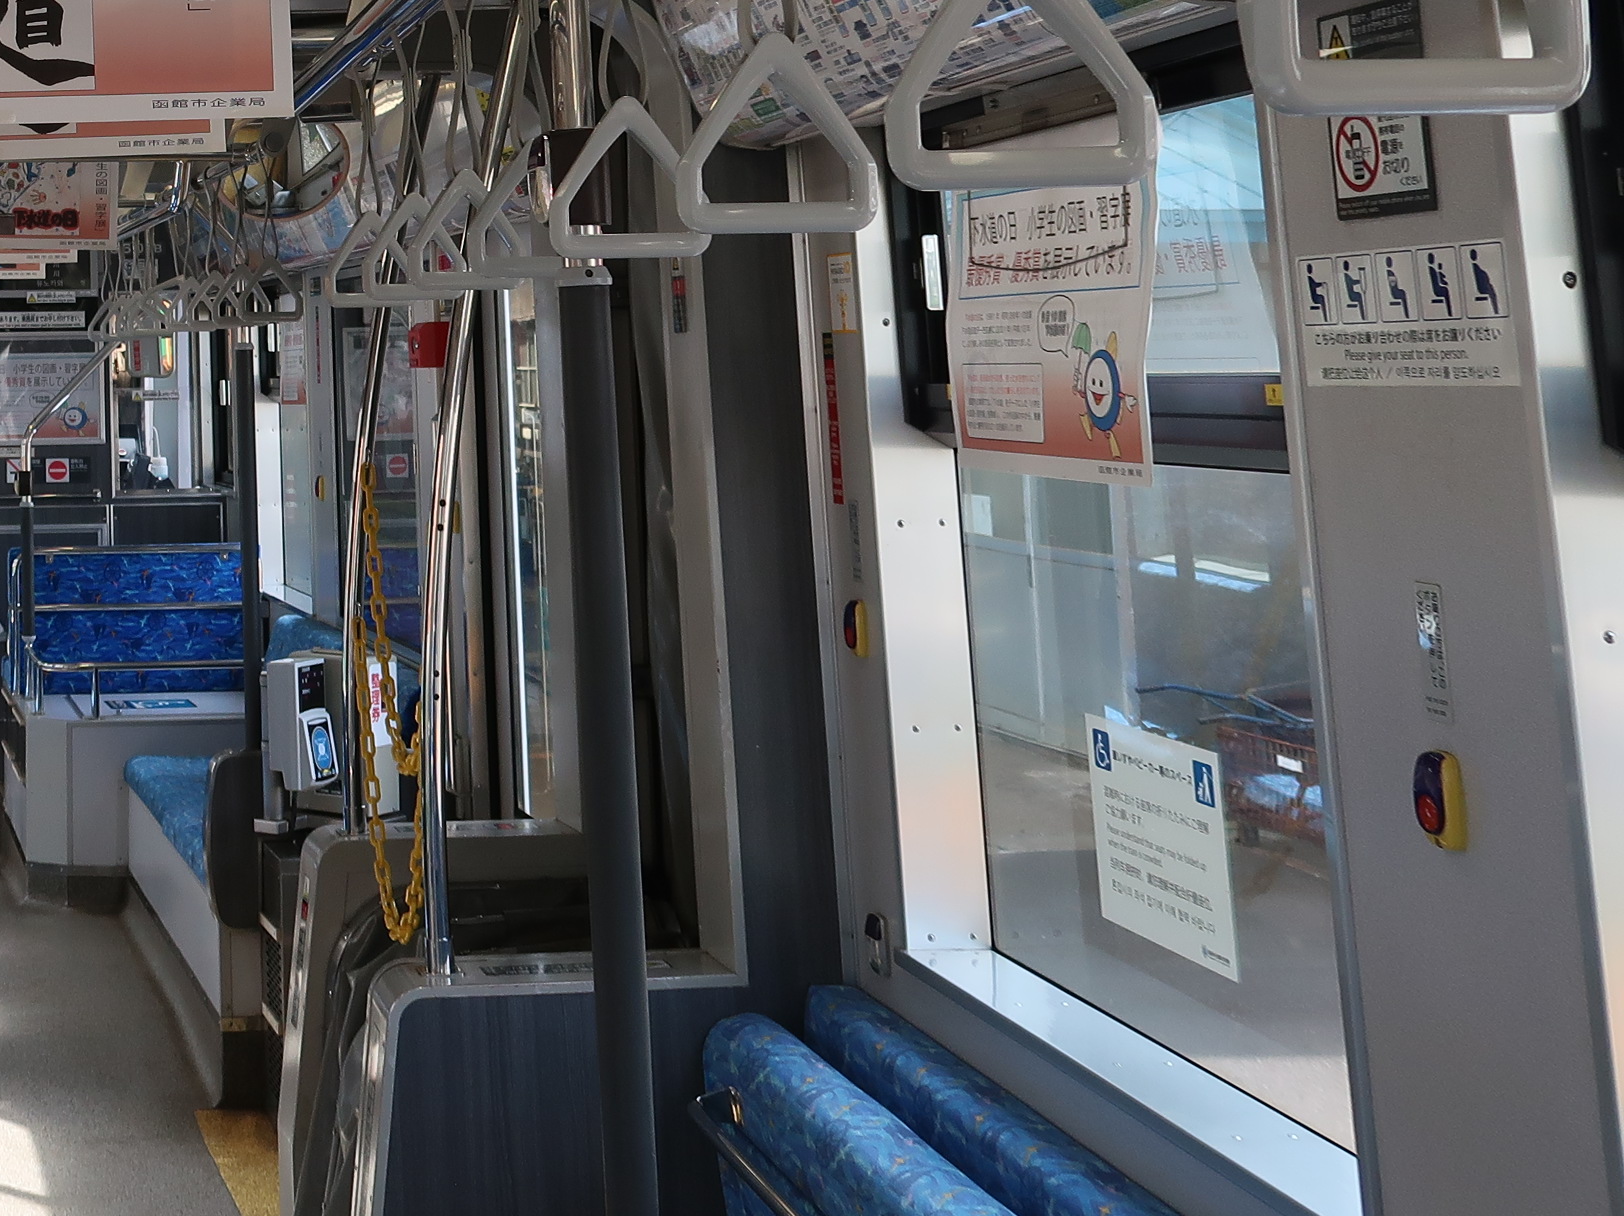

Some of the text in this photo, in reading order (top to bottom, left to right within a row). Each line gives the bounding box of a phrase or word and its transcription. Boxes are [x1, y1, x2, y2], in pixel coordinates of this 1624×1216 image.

[151, 97, 266, 109] 函館市企業局
[118, 138, 204, 148] 函館市企業局
[969, 210, 1018, 248] 下水道の日
[1343, 349, 1469, 363] Please give your seat to this person.
